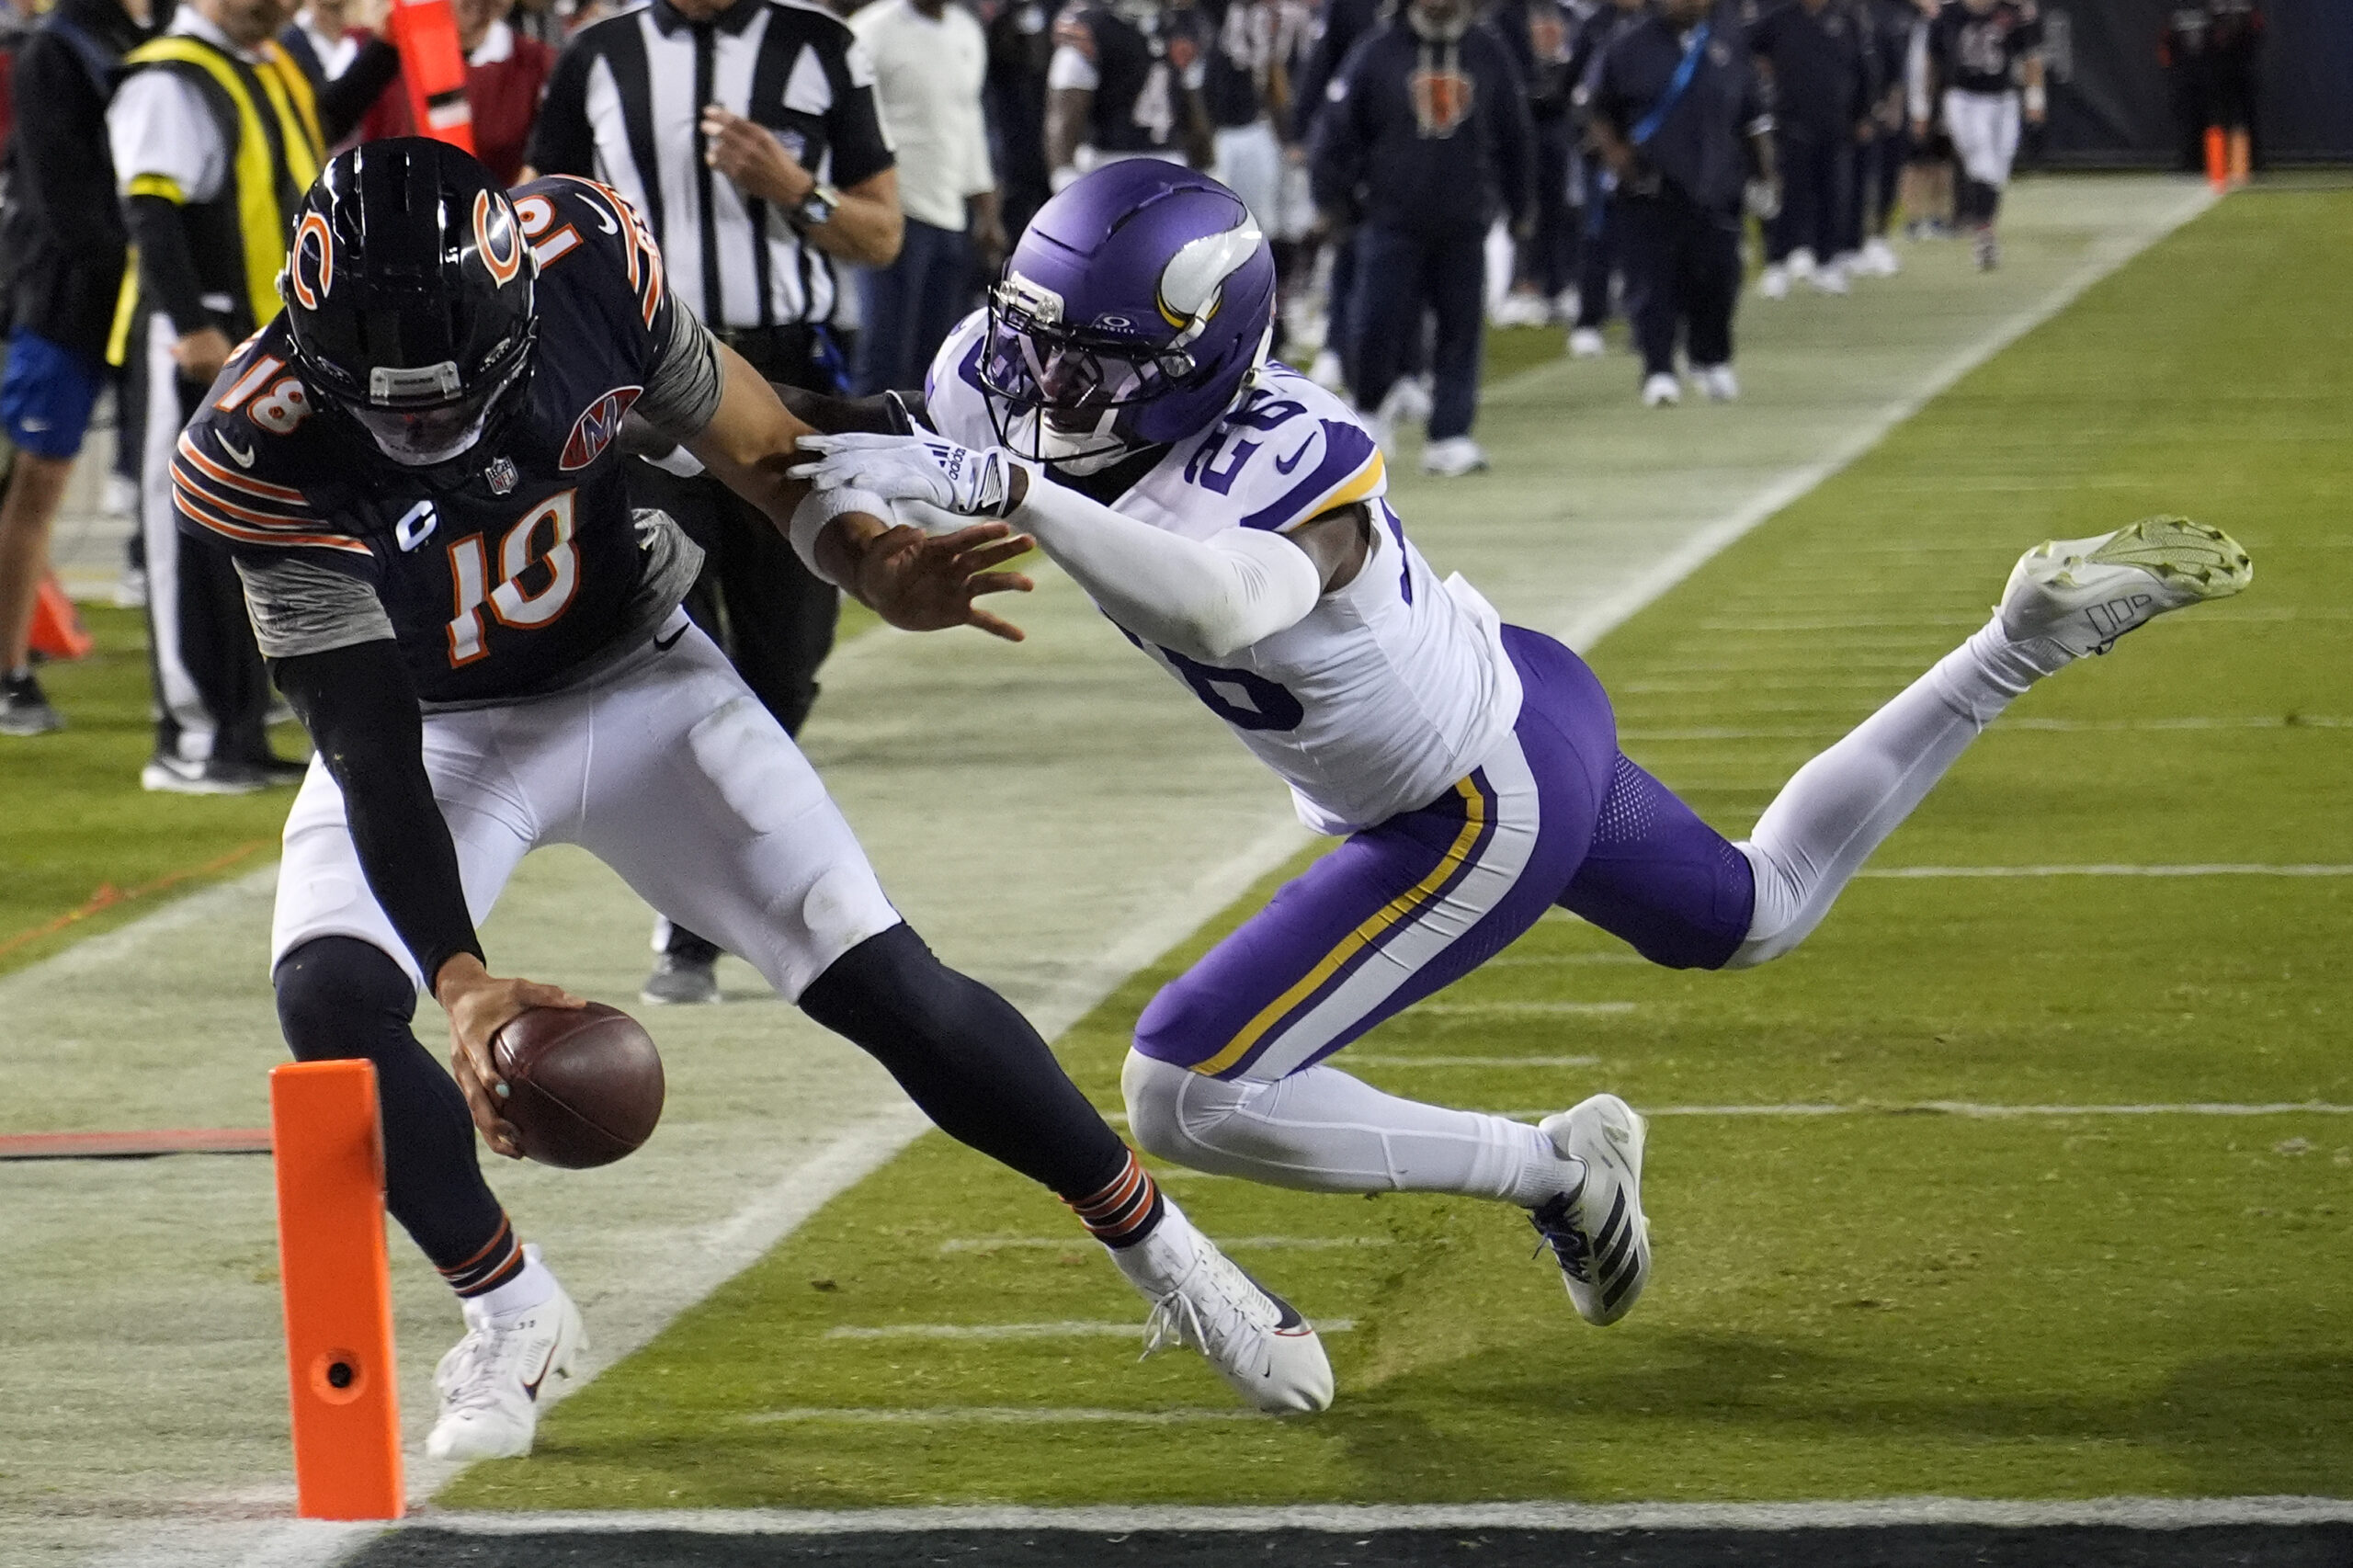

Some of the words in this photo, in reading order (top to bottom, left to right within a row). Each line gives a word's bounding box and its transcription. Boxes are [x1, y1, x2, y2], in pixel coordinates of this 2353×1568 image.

[213, 354, 313, 435] 18
[947, 447, 967, 481] adida
[1184, 389, 1308, 496] 26
[493, 468, 515, 490] NFL
[395, 500, 438, 552] C
